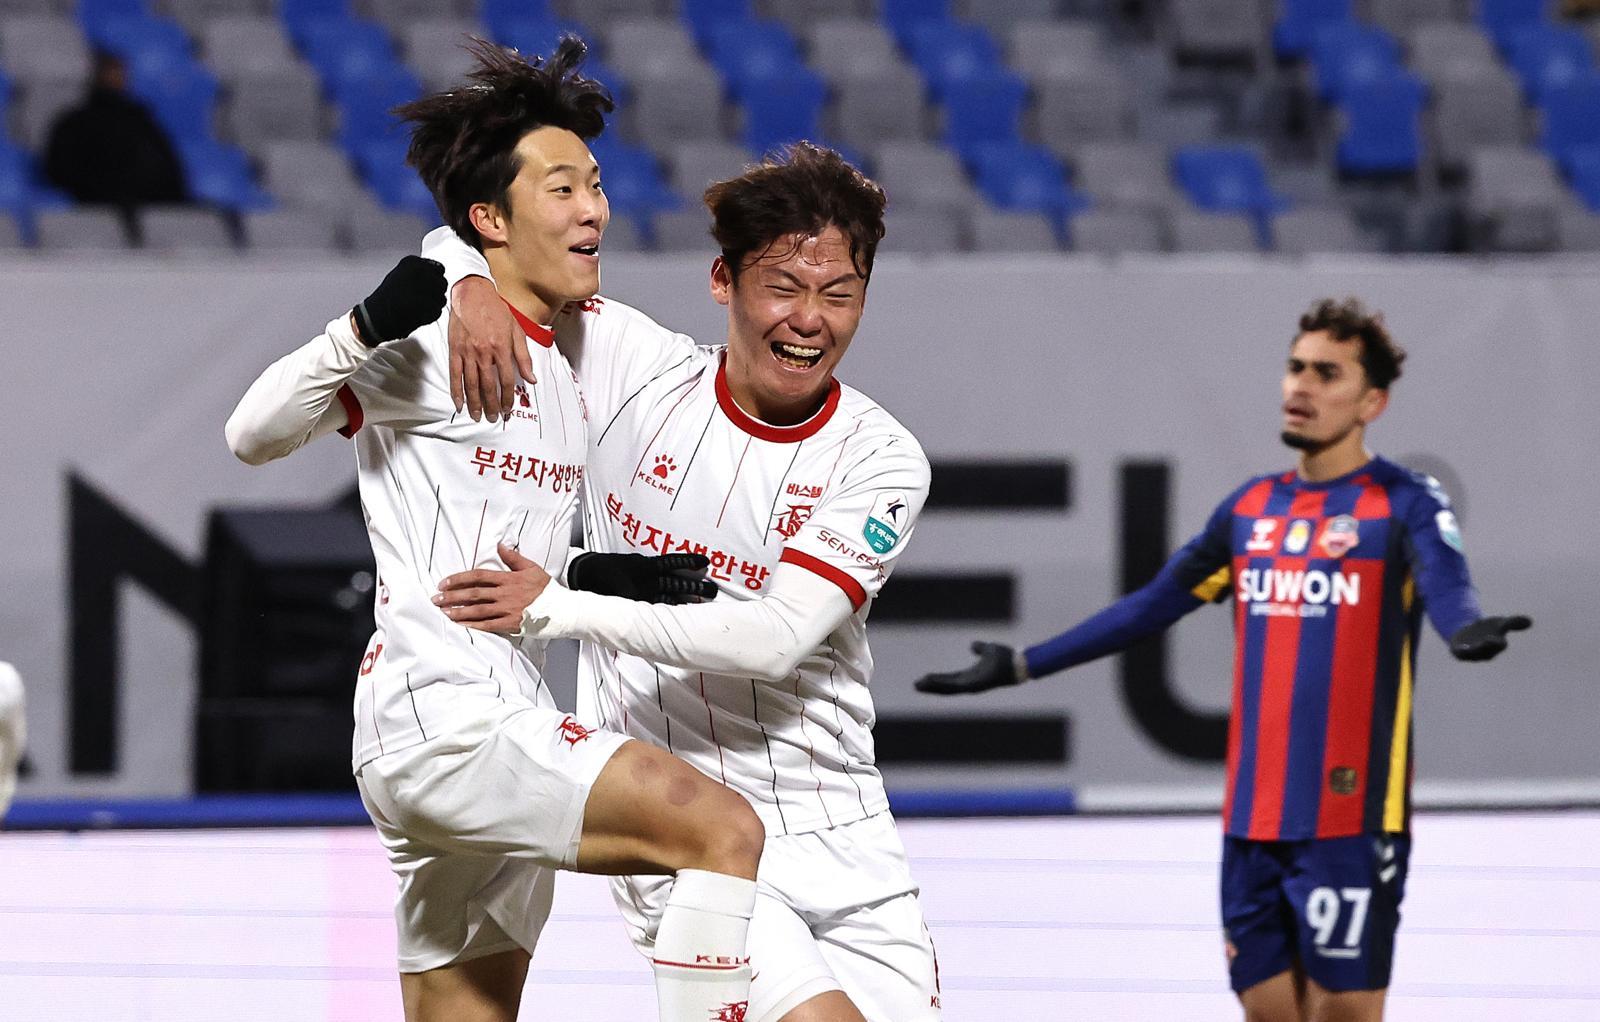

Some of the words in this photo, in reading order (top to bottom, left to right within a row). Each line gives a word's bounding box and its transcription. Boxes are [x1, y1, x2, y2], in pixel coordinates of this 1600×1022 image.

[510, 409, 539, 423] KELME
[637, 470, 675, 496] KELME
[1237, 567, 1361, 607] SUWON
[1306, 886, 1373, 948] 97
